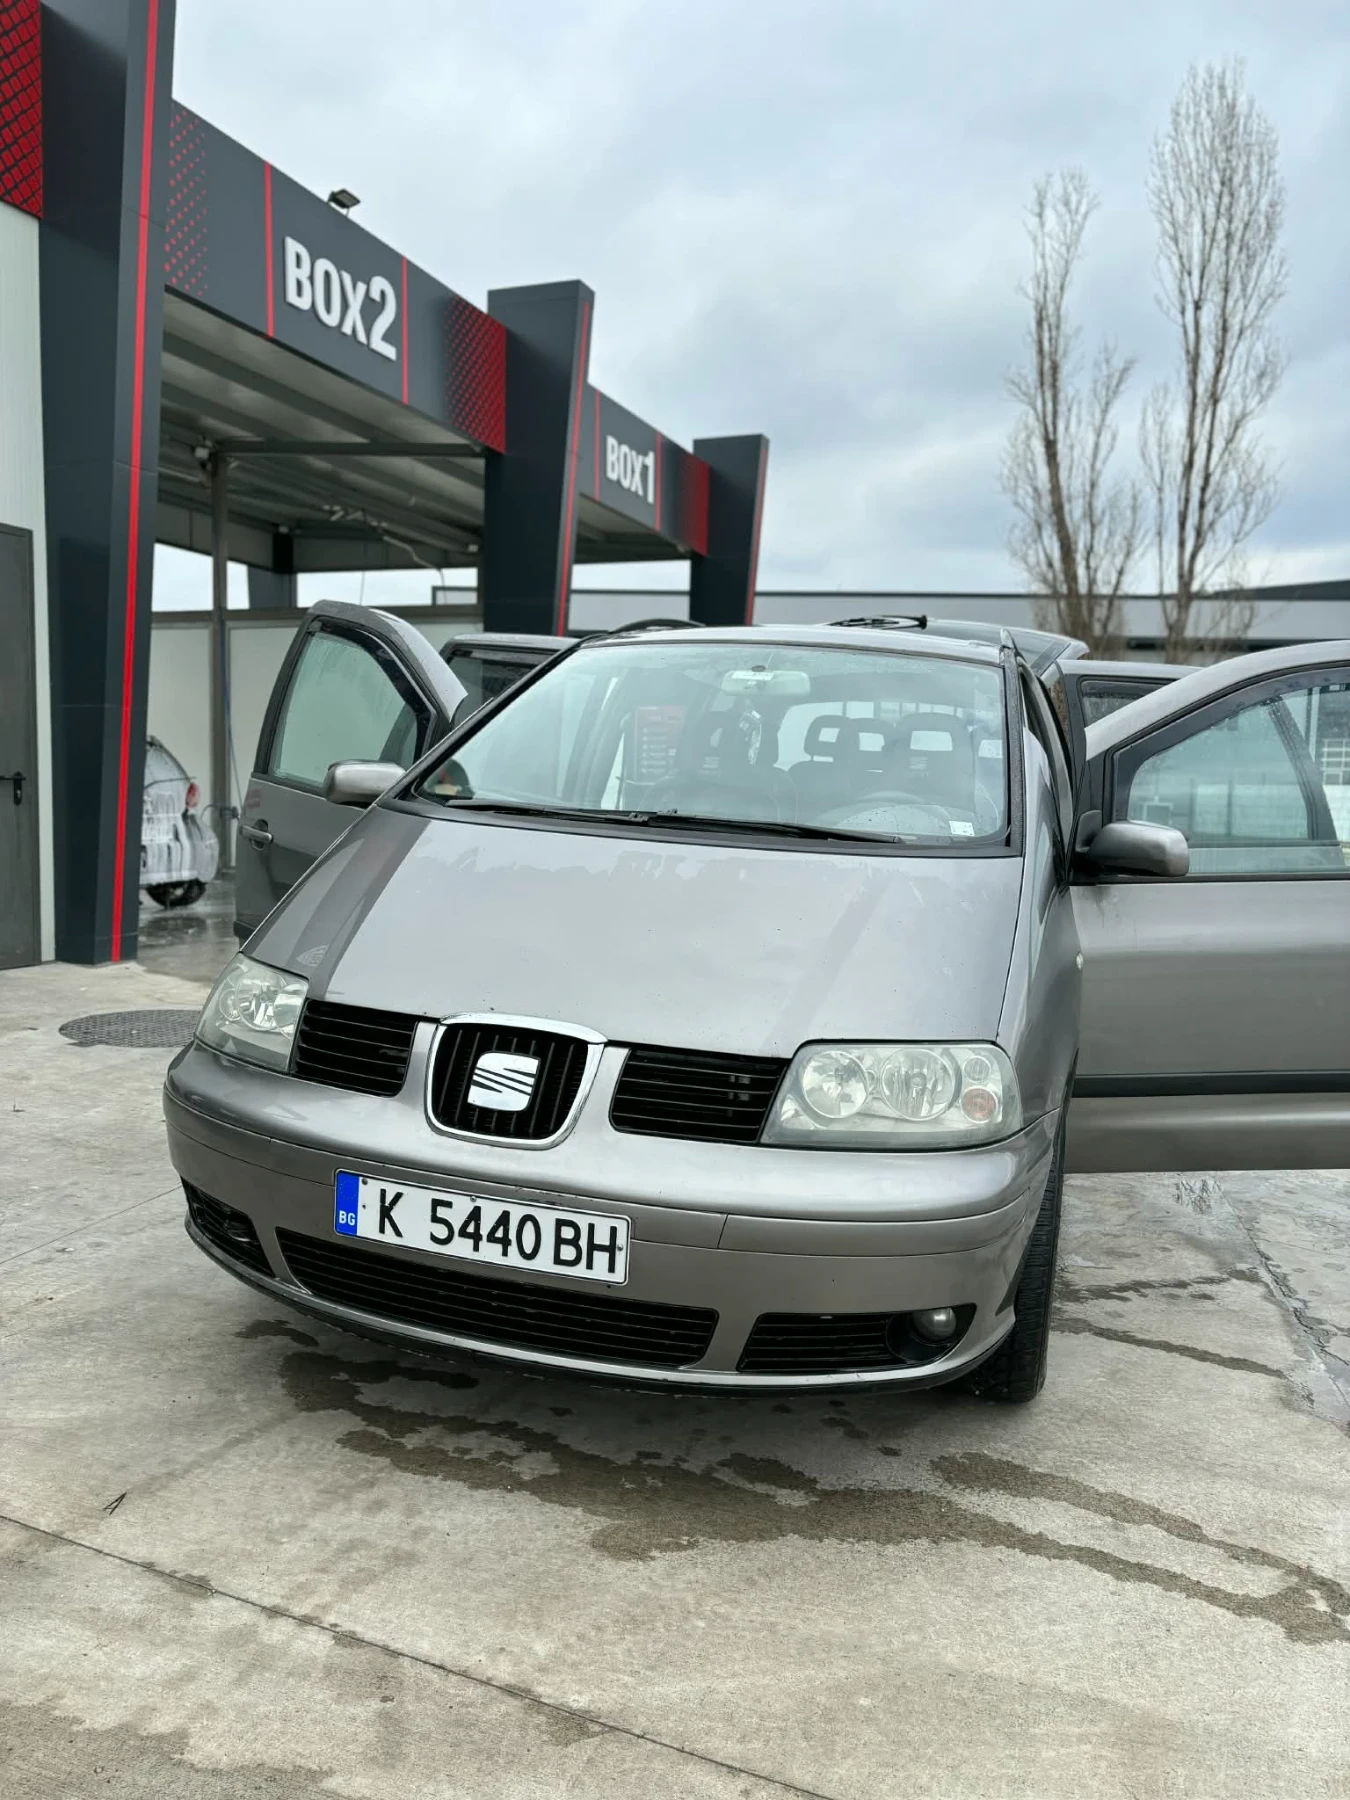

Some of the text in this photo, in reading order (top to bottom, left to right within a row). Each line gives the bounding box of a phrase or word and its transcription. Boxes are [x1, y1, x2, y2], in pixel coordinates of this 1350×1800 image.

[338, 1209, 356, 1226] BG
[378, 1188, 618, 1274] K 5440 BH
